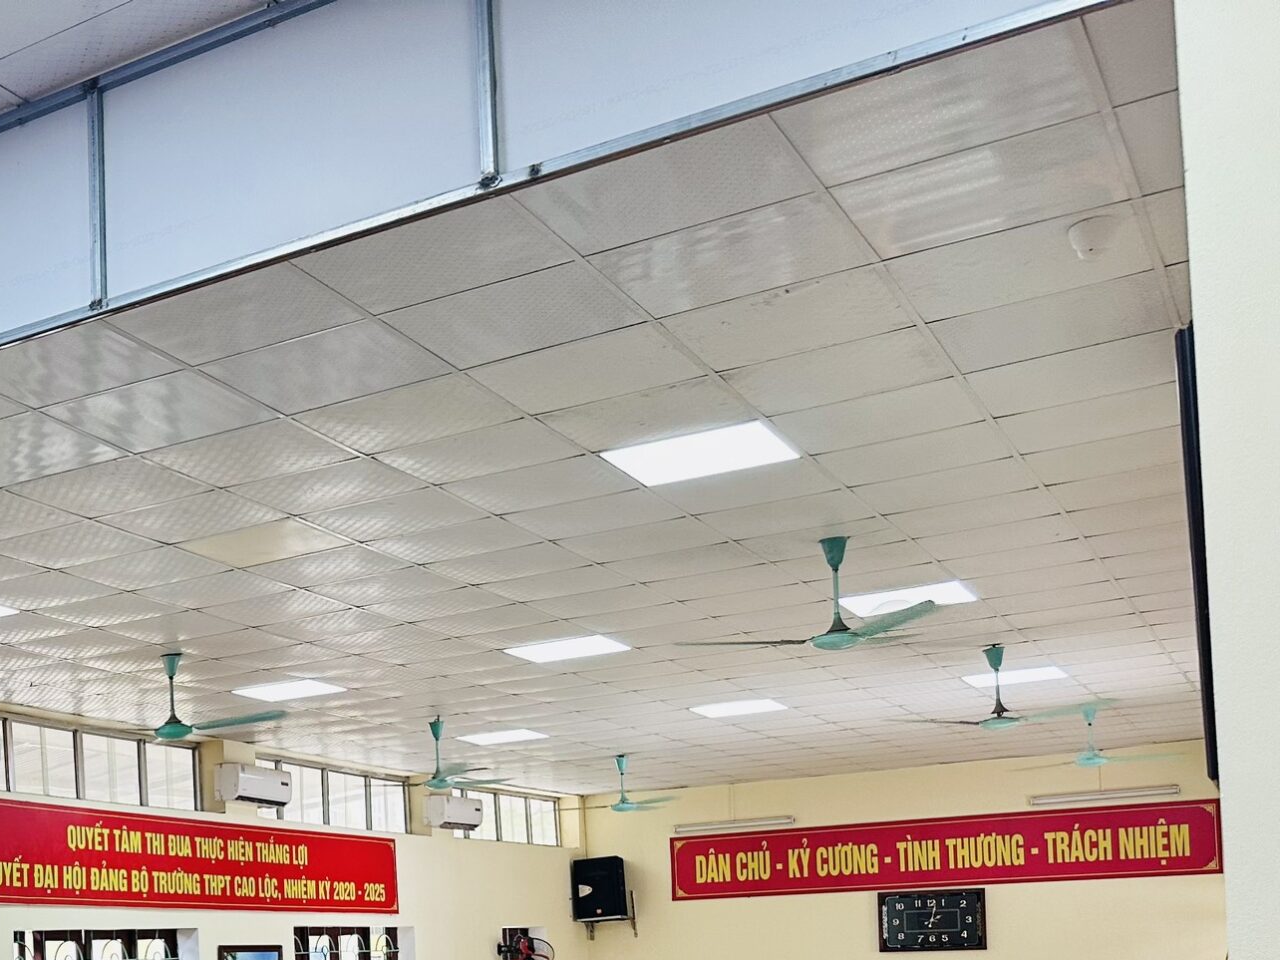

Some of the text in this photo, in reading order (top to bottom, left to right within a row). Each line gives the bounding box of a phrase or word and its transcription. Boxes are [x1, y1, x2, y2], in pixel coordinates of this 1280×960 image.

[67, 820, 308, 869] QUYẾT TÂM THI ĐUA THỰC HIỆN THẮNG LỢI
[695, 848, 731, 884] DÂN
[735, 840, 771, 882] CHỦ
[787, 838, 811, 878] KỶ
[816, 842, 879, 877] CƯƠNG
[896, 834, 941, 872] TÌNH
[945, 832, 1025, 869] THƯƠNG
[1044, 823, 1113, 864] TRÁCH
[1118, 817, 1191, 865] NHIỆM
[34, 864, 59, 894] ĐẠI
[63, 861, 87, 894] HỘI
[90, 860, 128, 891] ĐẢNG
[131, 866, 149, 897] BỘ
[152, 867, 201, 895] TRƯỜNG
[203, 874, 231, 896] THPT
[234, 876, 255, 897] CAO
[258, 873, 282, 902] LỘC,
[284, 875, 316, 903] NHIỆM
[319, 876, 330, 899] KỲ
[333, 882, 356, 901] 2020
[364, 883, 385, 902] 2025
[895, 902, 904, 910] 10
[915, 900, 921, 908] 11
[892, 918, 899, 926] 9
[941, 934, 948, 942] 5
[961, 930, 968, 938] 4
